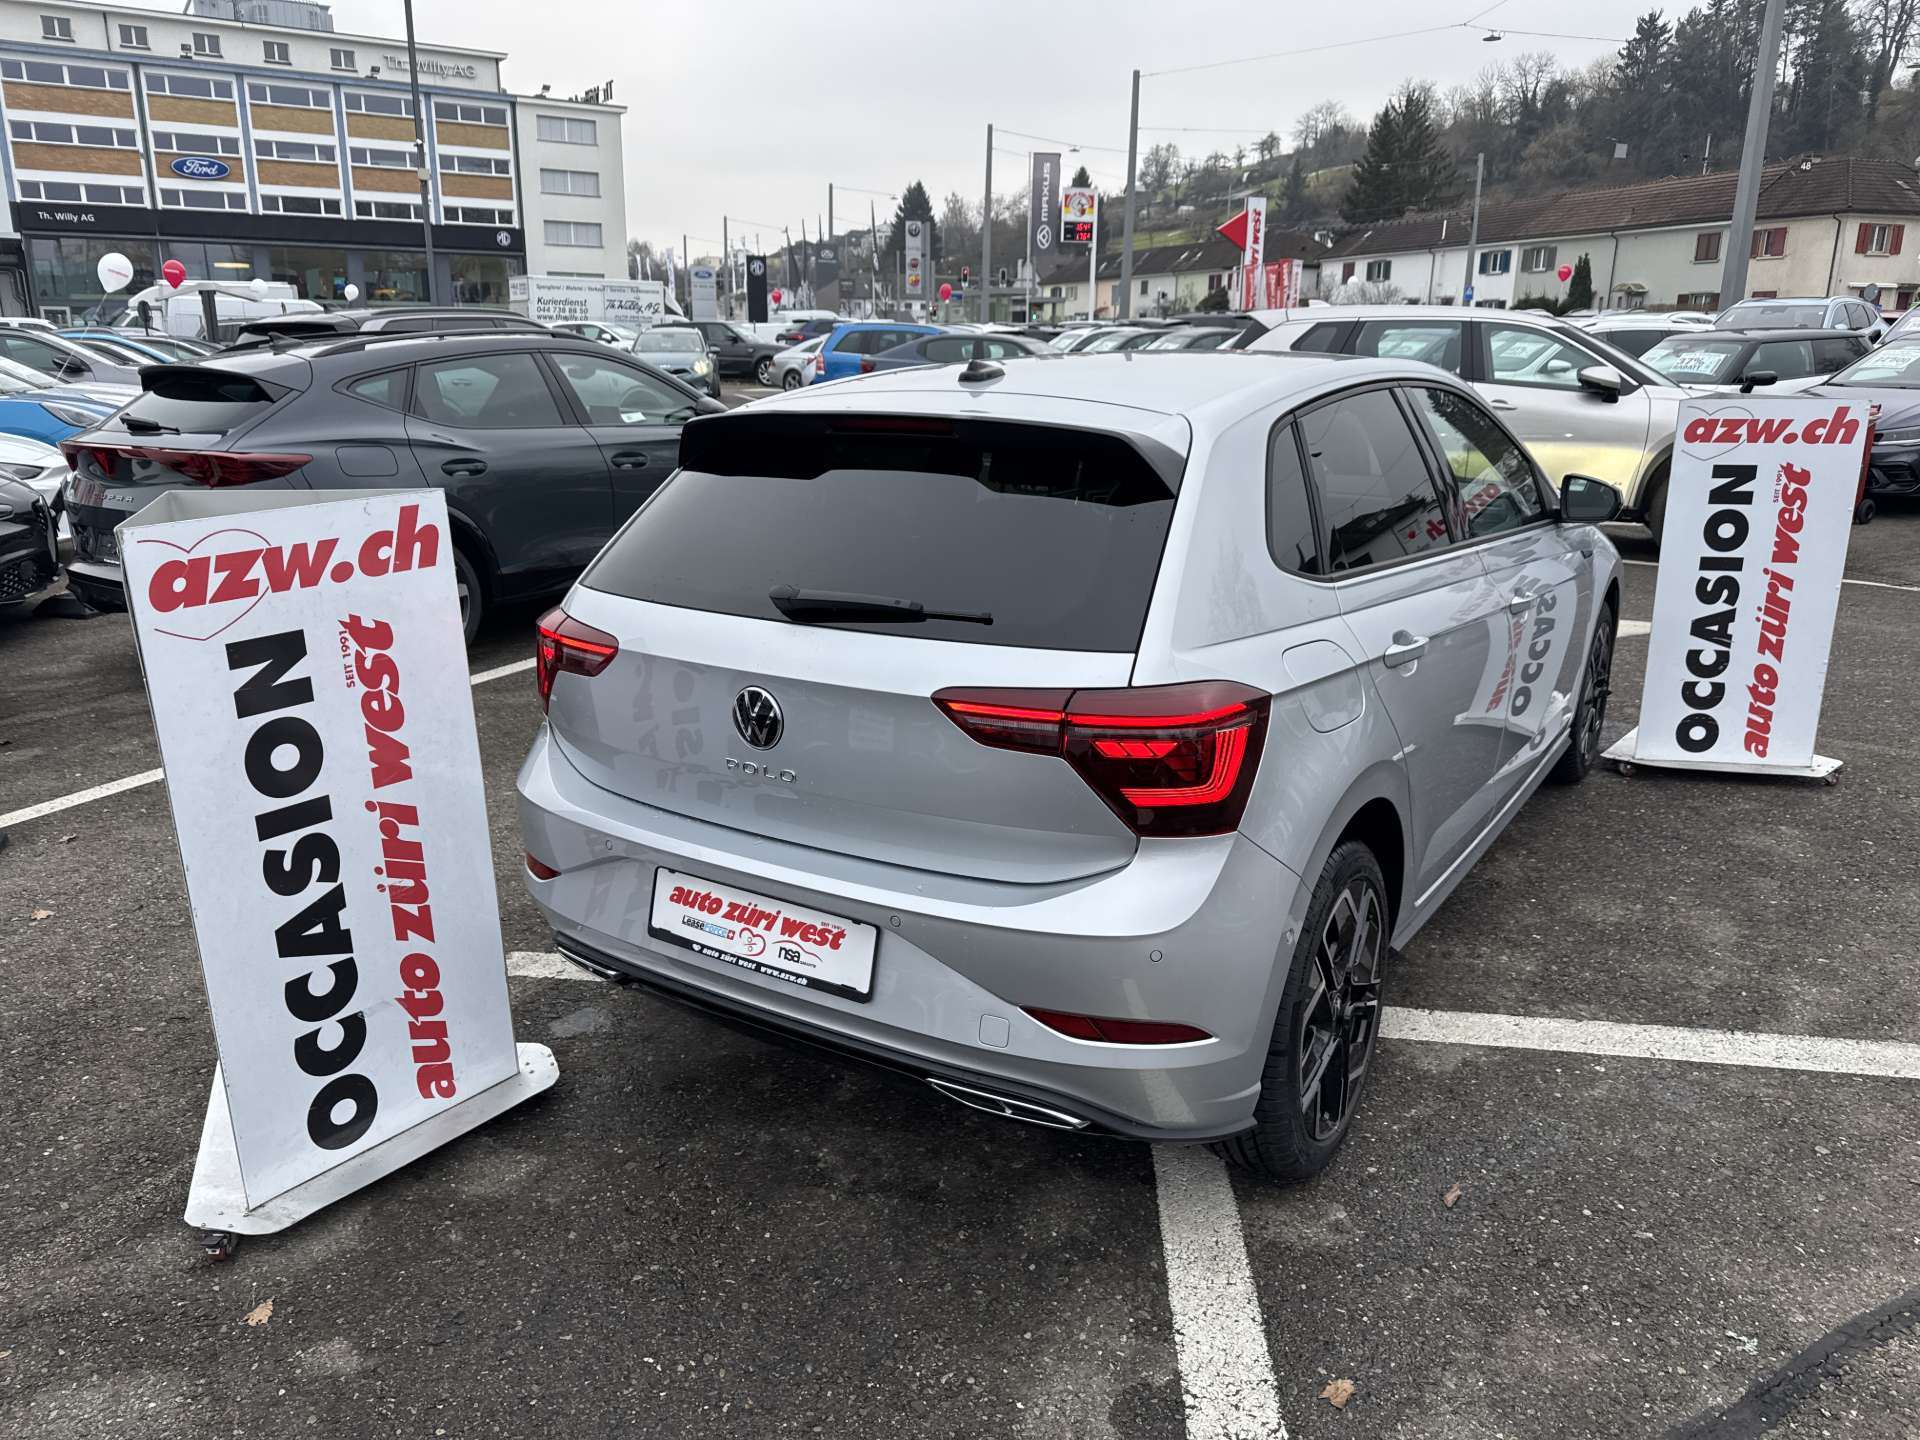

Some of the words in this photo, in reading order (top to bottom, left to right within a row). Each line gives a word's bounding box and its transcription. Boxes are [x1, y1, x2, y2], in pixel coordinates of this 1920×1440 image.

[416, 56, 449, 80] Willy
[453, 63, 477, 79] AG
[182, 159, 219, 176] Ford
[37, 211, 53, 220] Th.
[54, 212, 78, 223] Willy
[81, 213, 95, 222] AG
[536, 296, 587, 307] Kurierdienst
[1684, 406, 1860, 445] azw.ch
[1771, 462, 1811, 563] west
[148, 504, 440, 613] azw.ch
[1675, 464, 1758, 752] OCCASION
[1755, 568, 1794, 664] züri
[339, 630, 352, 661] 1991
[338, 613, 413, 790] west
[344, 664, 356, 689] SEIT
[1744, 663, 1779, 758] auto
[724, 757, 798, 784] POLO
[225, 629, 378, 1150] OCCASION
[365, 800, 435, 944] züri
[668, 886, 724, 916] auto
[721, 902, 782, 933] züri
[780, 916, 847, 951] west
[701, 947, 721, 960] auto
[738, 957, 757, 971] west
[778, 946, 801, 964] nsa
[394, 953, 457, 1100] auto
